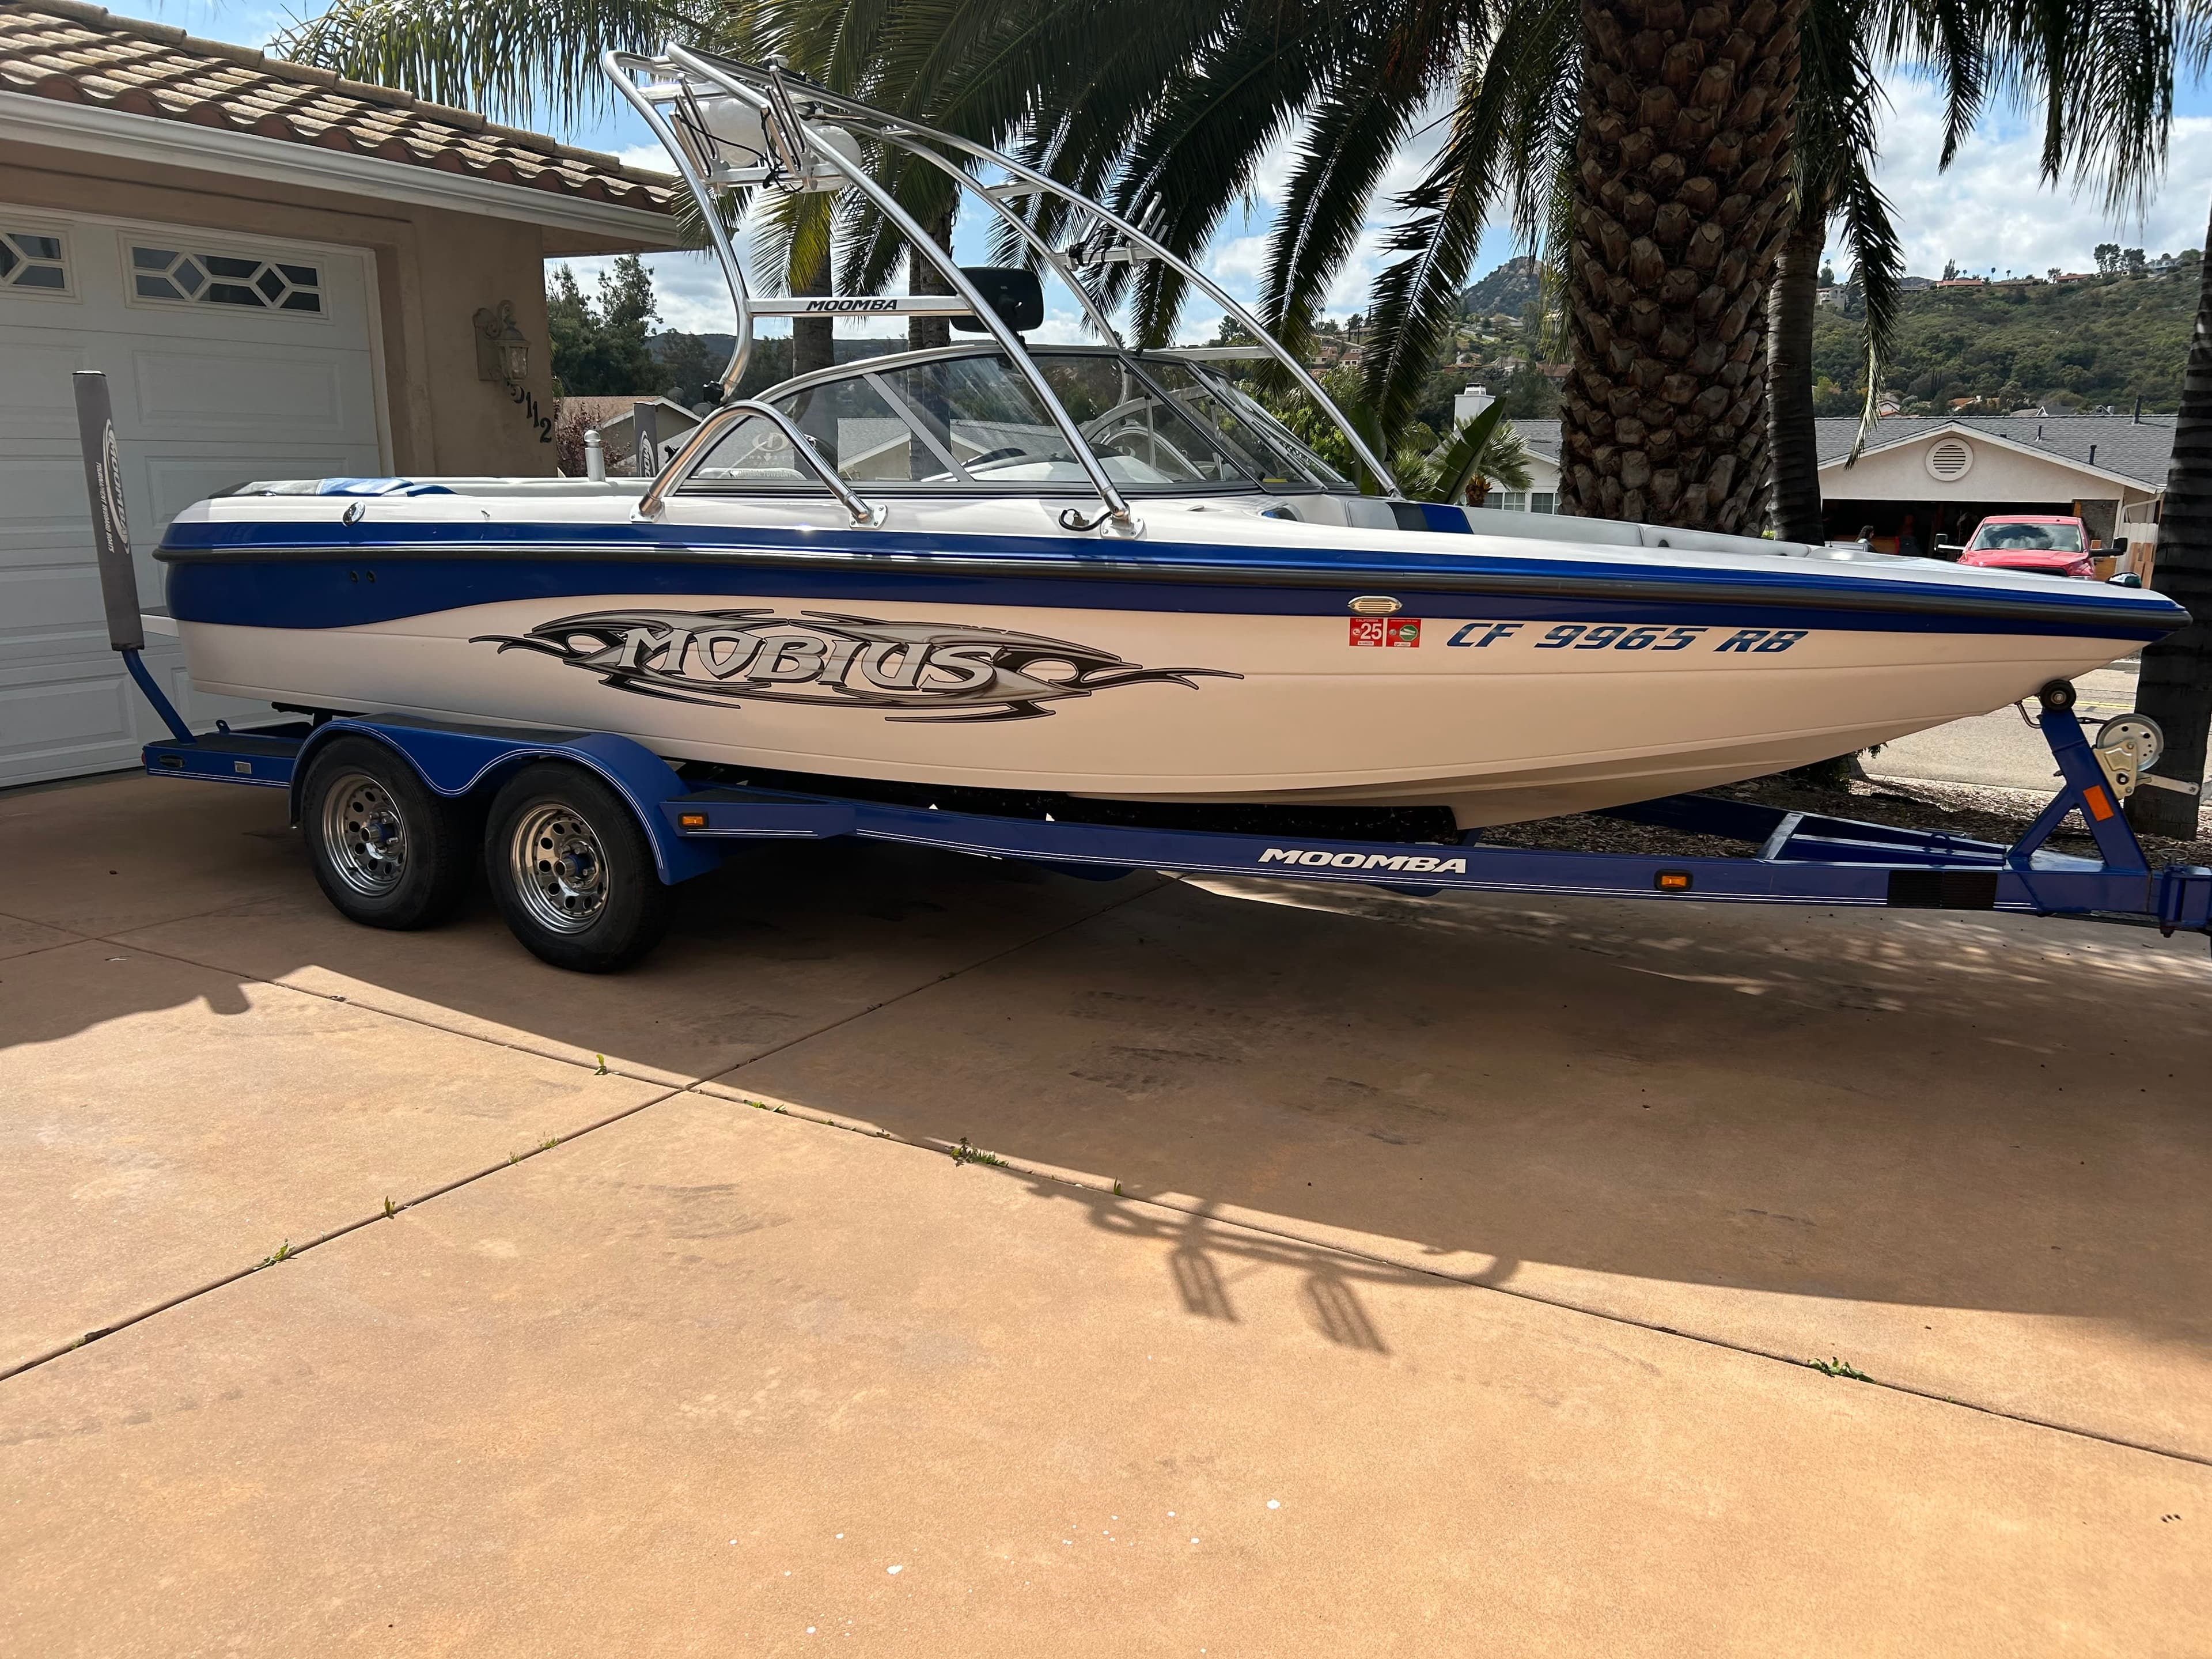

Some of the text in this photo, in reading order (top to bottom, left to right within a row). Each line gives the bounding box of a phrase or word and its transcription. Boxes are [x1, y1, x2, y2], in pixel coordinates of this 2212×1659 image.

[806, 299, 897, 311] MOOMBA
[108, 436, 128, 536] MOOMBA
[105, 532, 115, 554] BOATS
[1360, 623, 1382, 639] 25
[1446, 623, 1809, 653] CF 9965 RB
[615, 627, 1005, 692] MOBIUS
[1257, 847, 1467, 874] MOOMBA
